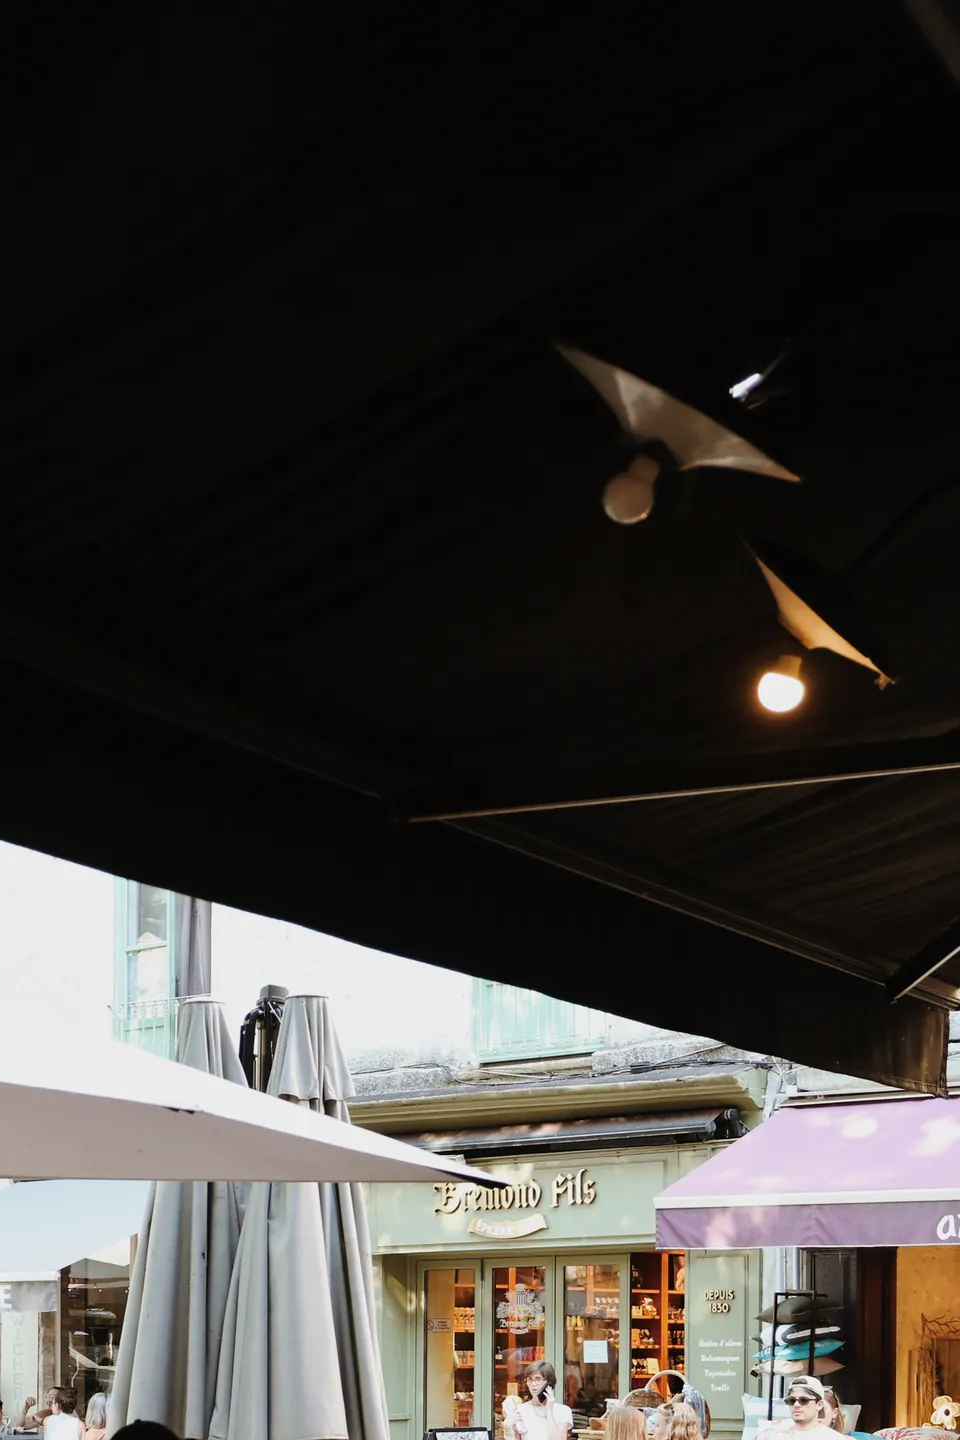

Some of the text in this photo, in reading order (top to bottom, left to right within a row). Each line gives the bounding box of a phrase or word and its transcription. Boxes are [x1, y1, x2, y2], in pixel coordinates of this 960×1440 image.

[433, 1168, 597, 1214] Bremond Fils
[704, 1289, 735, 1300] DEPUIS
[708, 1302, 730, 1313] 1830
